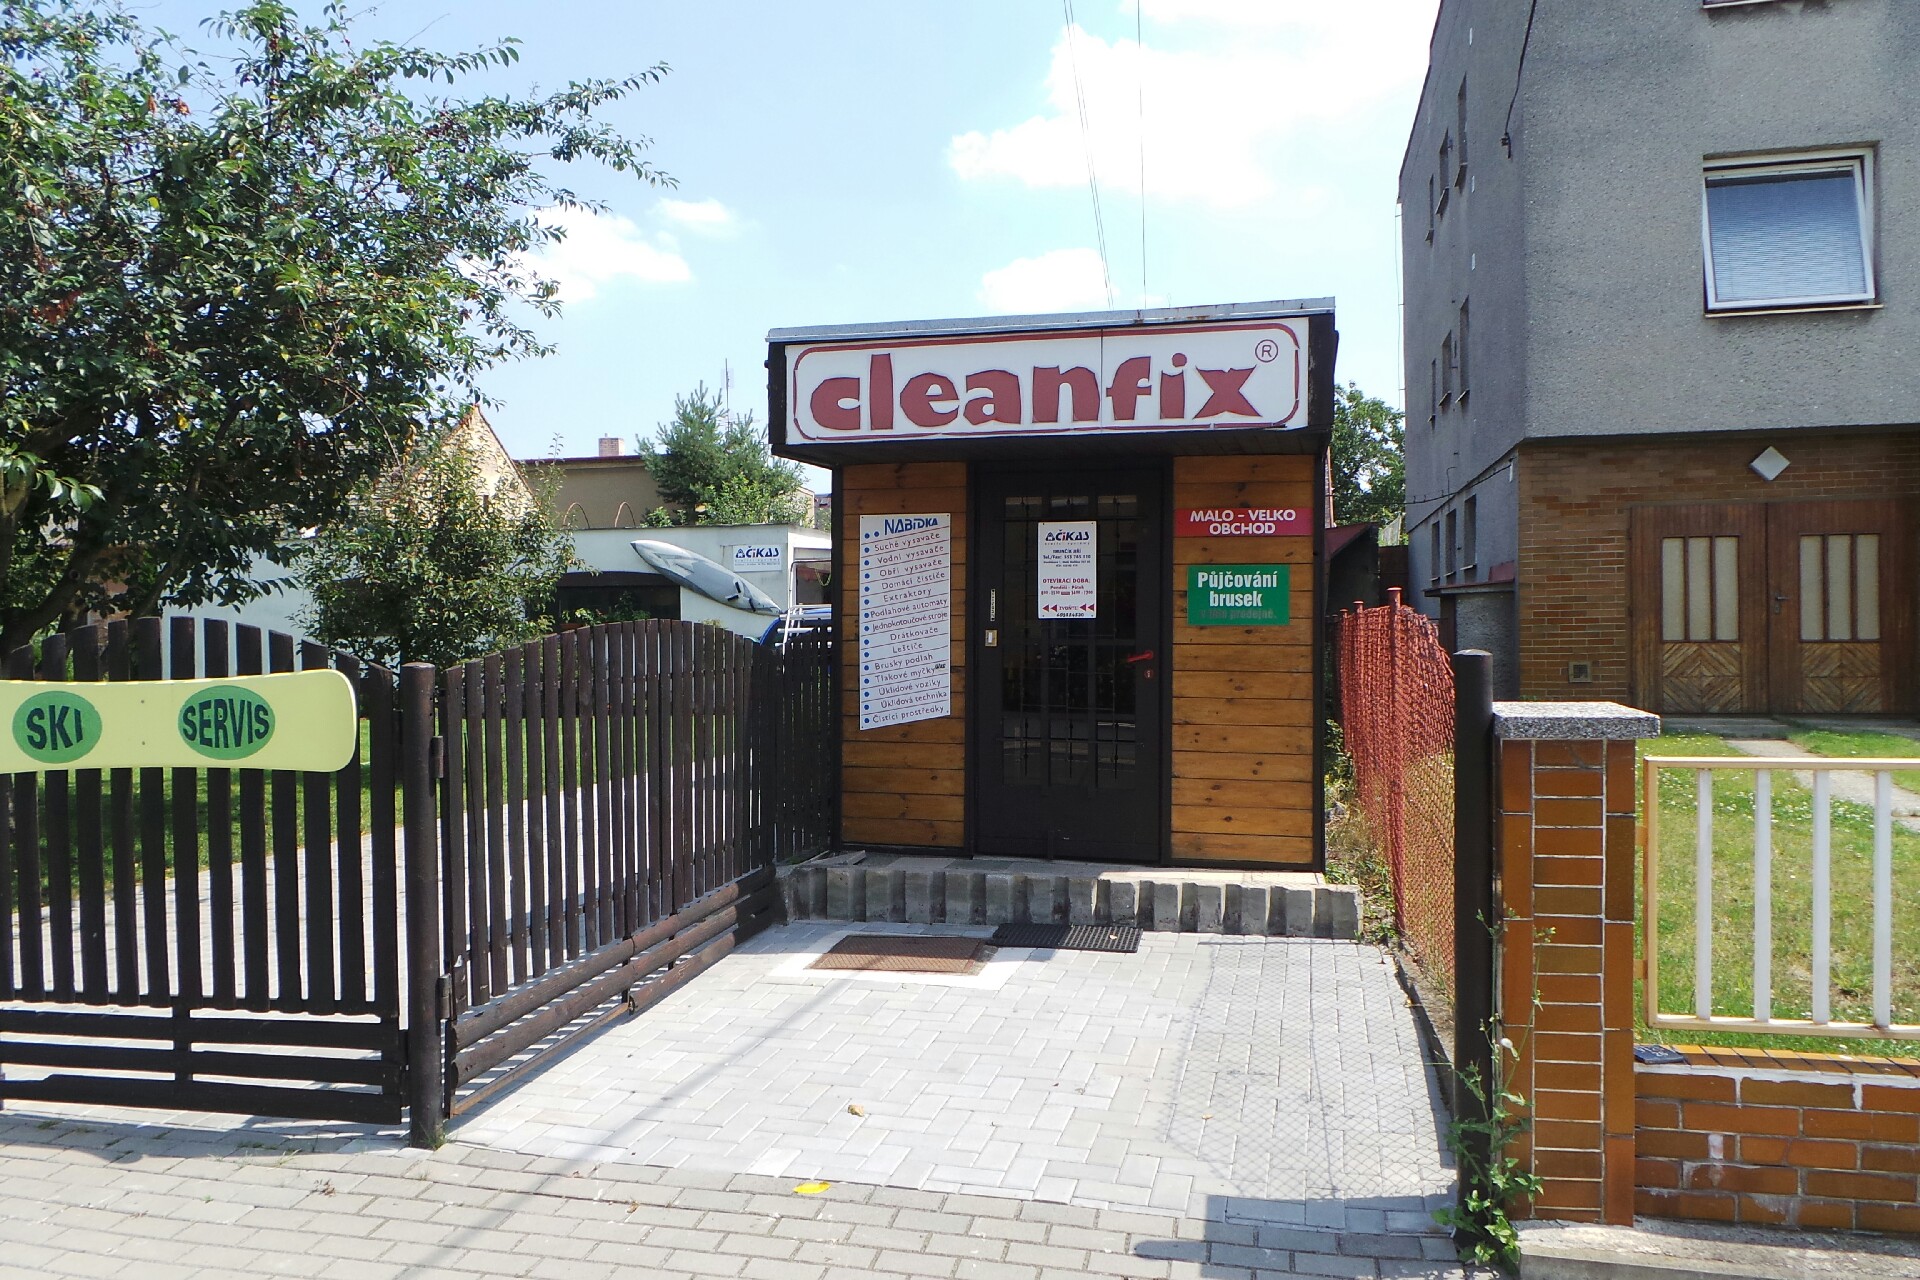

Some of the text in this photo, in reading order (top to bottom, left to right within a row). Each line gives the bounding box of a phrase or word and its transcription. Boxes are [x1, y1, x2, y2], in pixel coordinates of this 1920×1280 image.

[809, 352, 1262, 431] cleanfix
[1190, 510, 1234, 522] MALO
[1248, 509, 1296, 521] VELKO
[1209, 522, 1276, 535] OBCHOD
[874, 533, 940, 552] Suché vysavače
[877, 545, 944, 564] Vodní vysavače
[879, 559, 943, 577] Obří vysavače
[881, 577, 913, 590] Domácí
[1197, 571, 1278, 590] Půjčování
[883, 588, 931, 603] Extraktory
[1209, 590, 1262, 607] brusek
[870, 598, 948, 619] Podlahové automaty
[928, 612, 948, 621] stroje
[890, 627, 938, 641] Drátkovače
[892, 642, 923, 654] Leštiče
[874, 653, 933, 671] Brusky podlah
[874, 671, 908, 683] Tlakové
[915, 691, 947, 702] technika
[901, 705, 944, 720] prostředky
[26, 704, 84, 751] SKI
[182, 698, 270, 748] SERVIS
